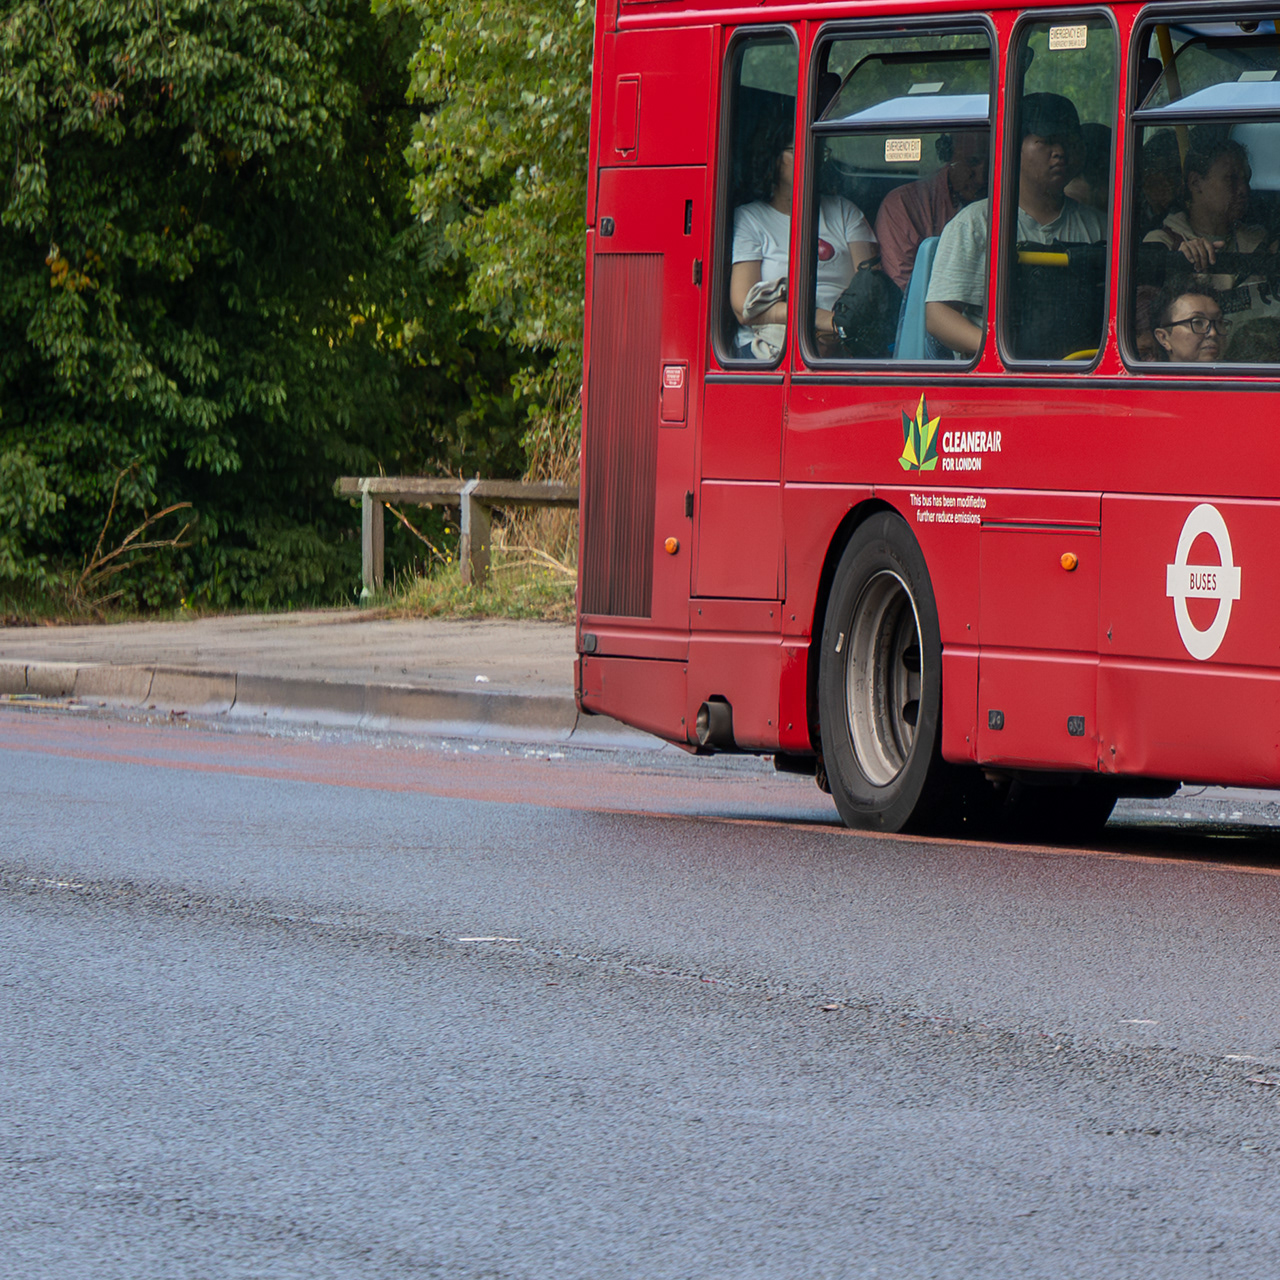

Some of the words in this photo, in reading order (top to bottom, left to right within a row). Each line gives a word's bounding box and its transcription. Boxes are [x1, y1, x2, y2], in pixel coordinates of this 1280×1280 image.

[942, 458, 954, 471] FOR
[956, 457, 981, 471] LONDON
[910, 494, 921, 506] This
[922, 494, 932, 506] bus
[933, 495, 942, 507] has
[943, 495, 956, 507] been
[917, 509, 935, 522] further
[936, 511, 954, 523] reduce
[955, 512, 981, 524] emissions
[1190, 573, 1217, 591] BUSES
